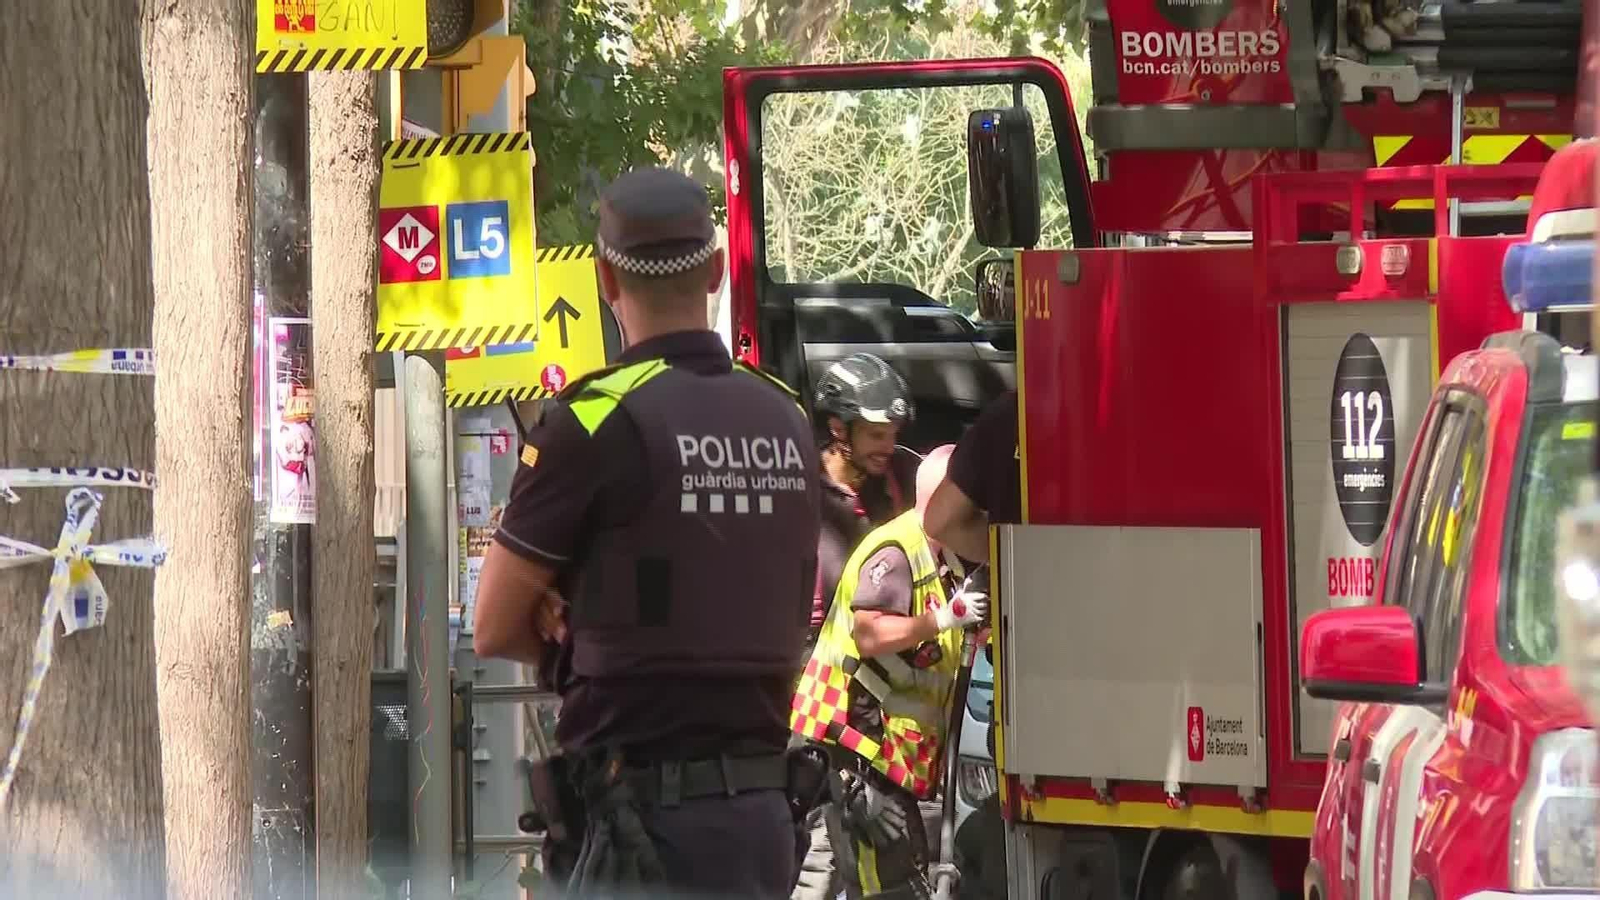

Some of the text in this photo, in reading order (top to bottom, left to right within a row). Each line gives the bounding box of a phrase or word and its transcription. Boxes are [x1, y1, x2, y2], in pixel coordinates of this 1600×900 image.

[1121, 30, 1280, 58] BOMBERS
[1123, 58, 1281, 76] bcn.cat/bombers
[397, 226, 419, 250] M
[453, 216, 505, 260] L5
[1340, 390, 1385, 459] 112
[676, 434, 806, 470] POLICIA
[682, 471, 807, 491] guàrdia urbana
[1327, 557, 1379, 598] BOMB
[1206, 715, 1244, 737] Ajuntament
[1206, 738, 1249, 756] de Barcelona
